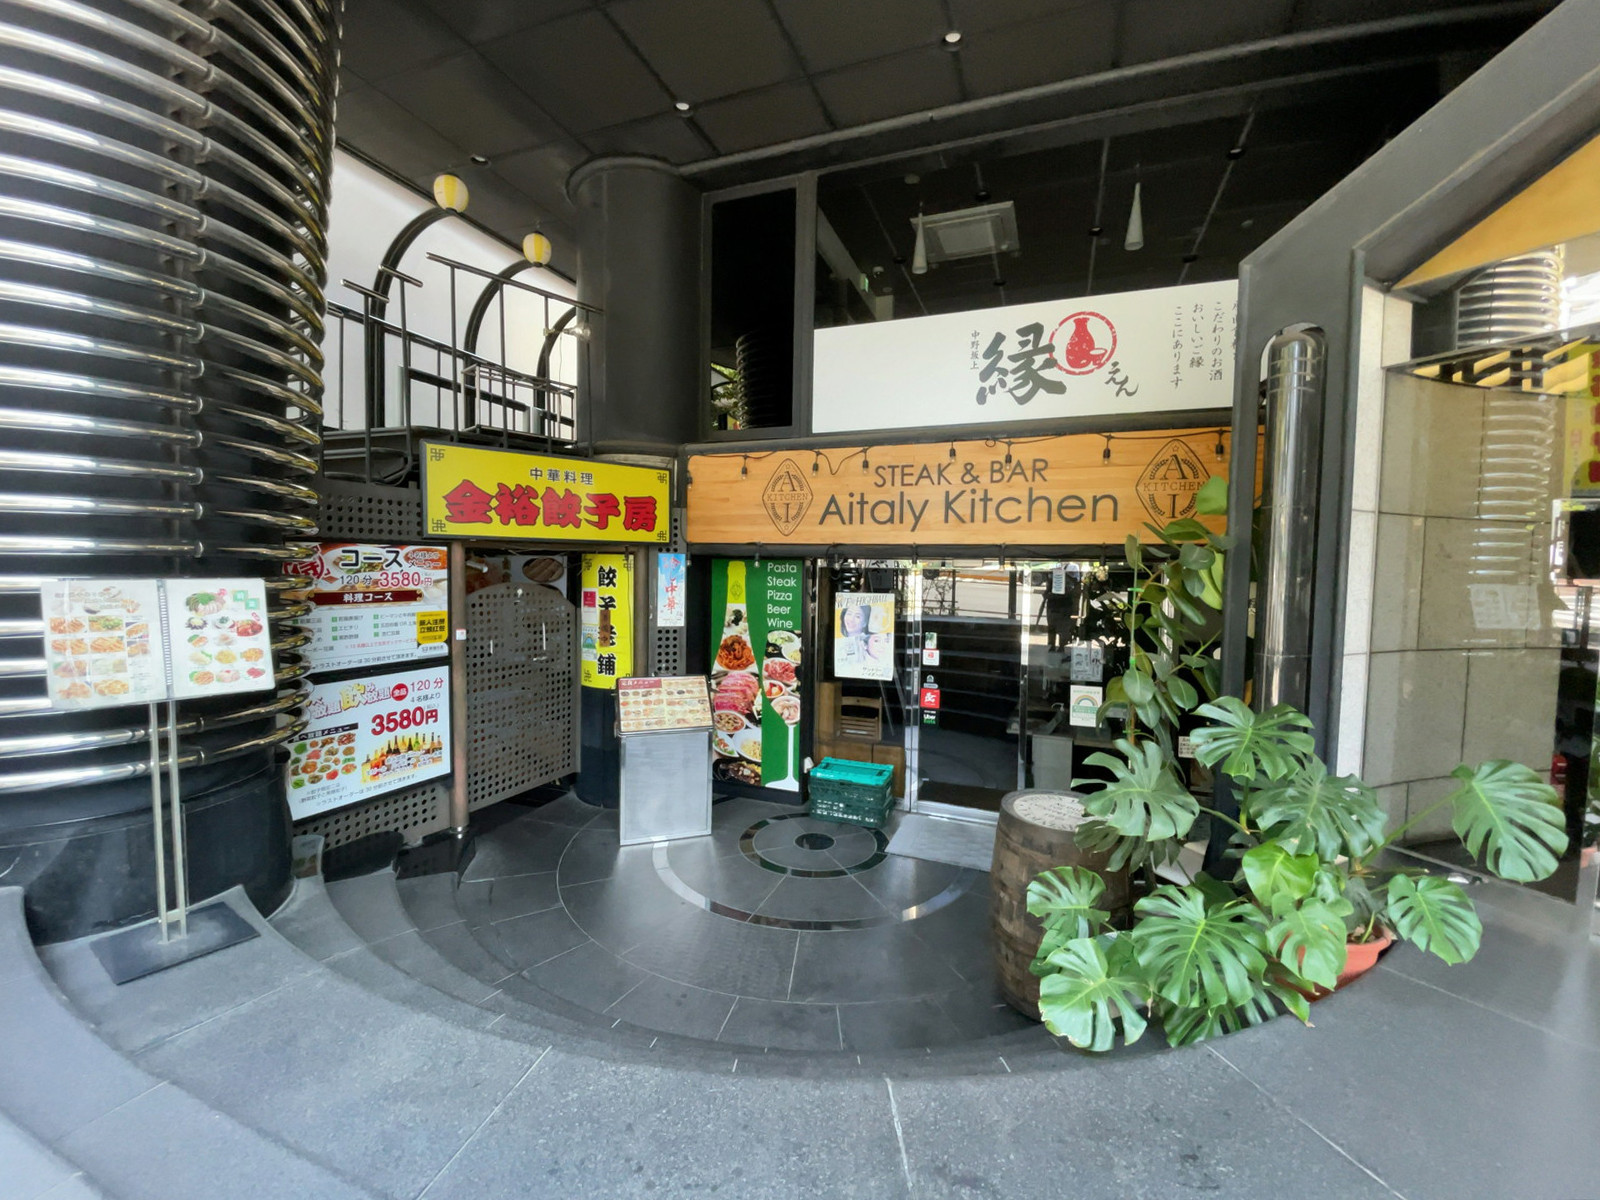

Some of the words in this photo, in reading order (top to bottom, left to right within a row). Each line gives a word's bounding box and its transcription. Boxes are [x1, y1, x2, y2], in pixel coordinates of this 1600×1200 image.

[970, 330, 980, 370] 中野坂上
[1170, 305, 1183, 389] ここにあります
[1190, 303, 1205, 369] おいしいご縁
[1209, 301, 1225, 381] こだわりのお酒
[976, 322, 1067, 405] 縁
[1105, 362, 1140, 398] えん
[530, 467, 594, 485] 中華料理
[874, 463, 952, 488] STEAK
[961, 462, 981, 484] &
[990, 458, 1049, 483] BAR
[442, 479, 658, 533] 金裕餃子房
[767, 493, 808, 501] KITCHEN
[819, 490, 930, 533] Aitaly
[944, 487, 1118, 525] Kitchen
[339, 549, 402, 568] コース
[768, 563, 797, 573] Pasta
[767, 576, 797, 587] Steak
[768, 590, 792, 600] Pizza
[343, 592, 393, 603] 料理コース
[767, 604, 791, 614] Beer
[767, 618, 793, 628] Wine
[371, 706, 439, 736] 3580円
